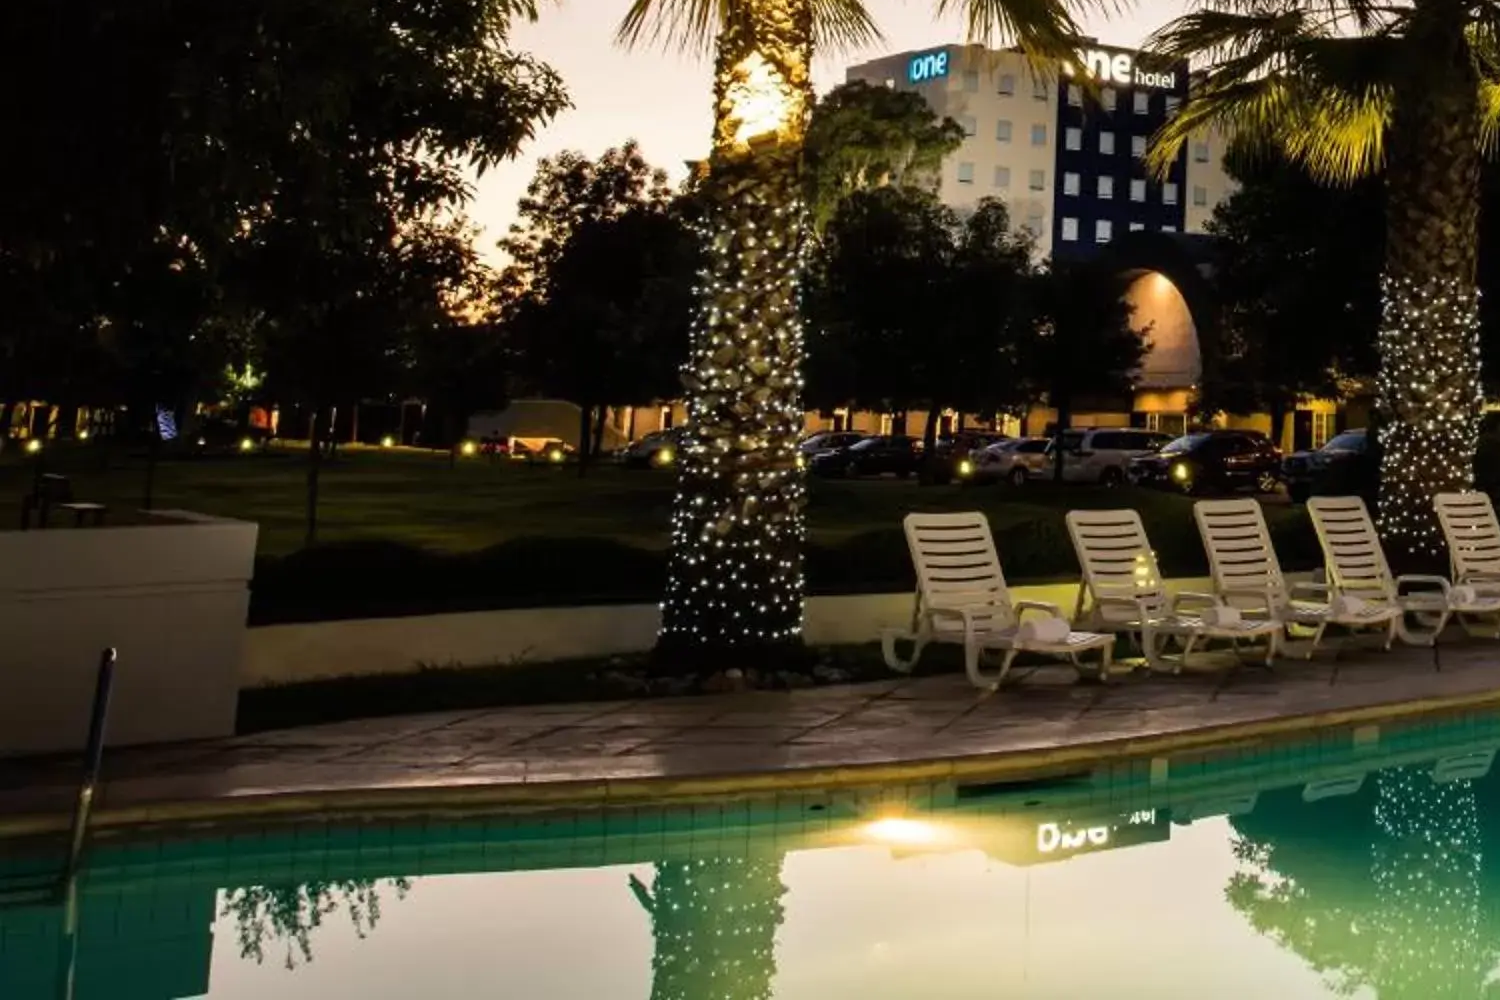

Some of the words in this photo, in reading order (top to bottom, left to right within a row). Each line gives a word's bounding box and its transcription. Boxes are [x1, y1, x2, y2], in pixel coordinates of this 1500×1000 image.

[911, 51, 947, 80] one
[1062, 47, 1131, 83] ne
[1134, 67, 1175, 89] hotel
